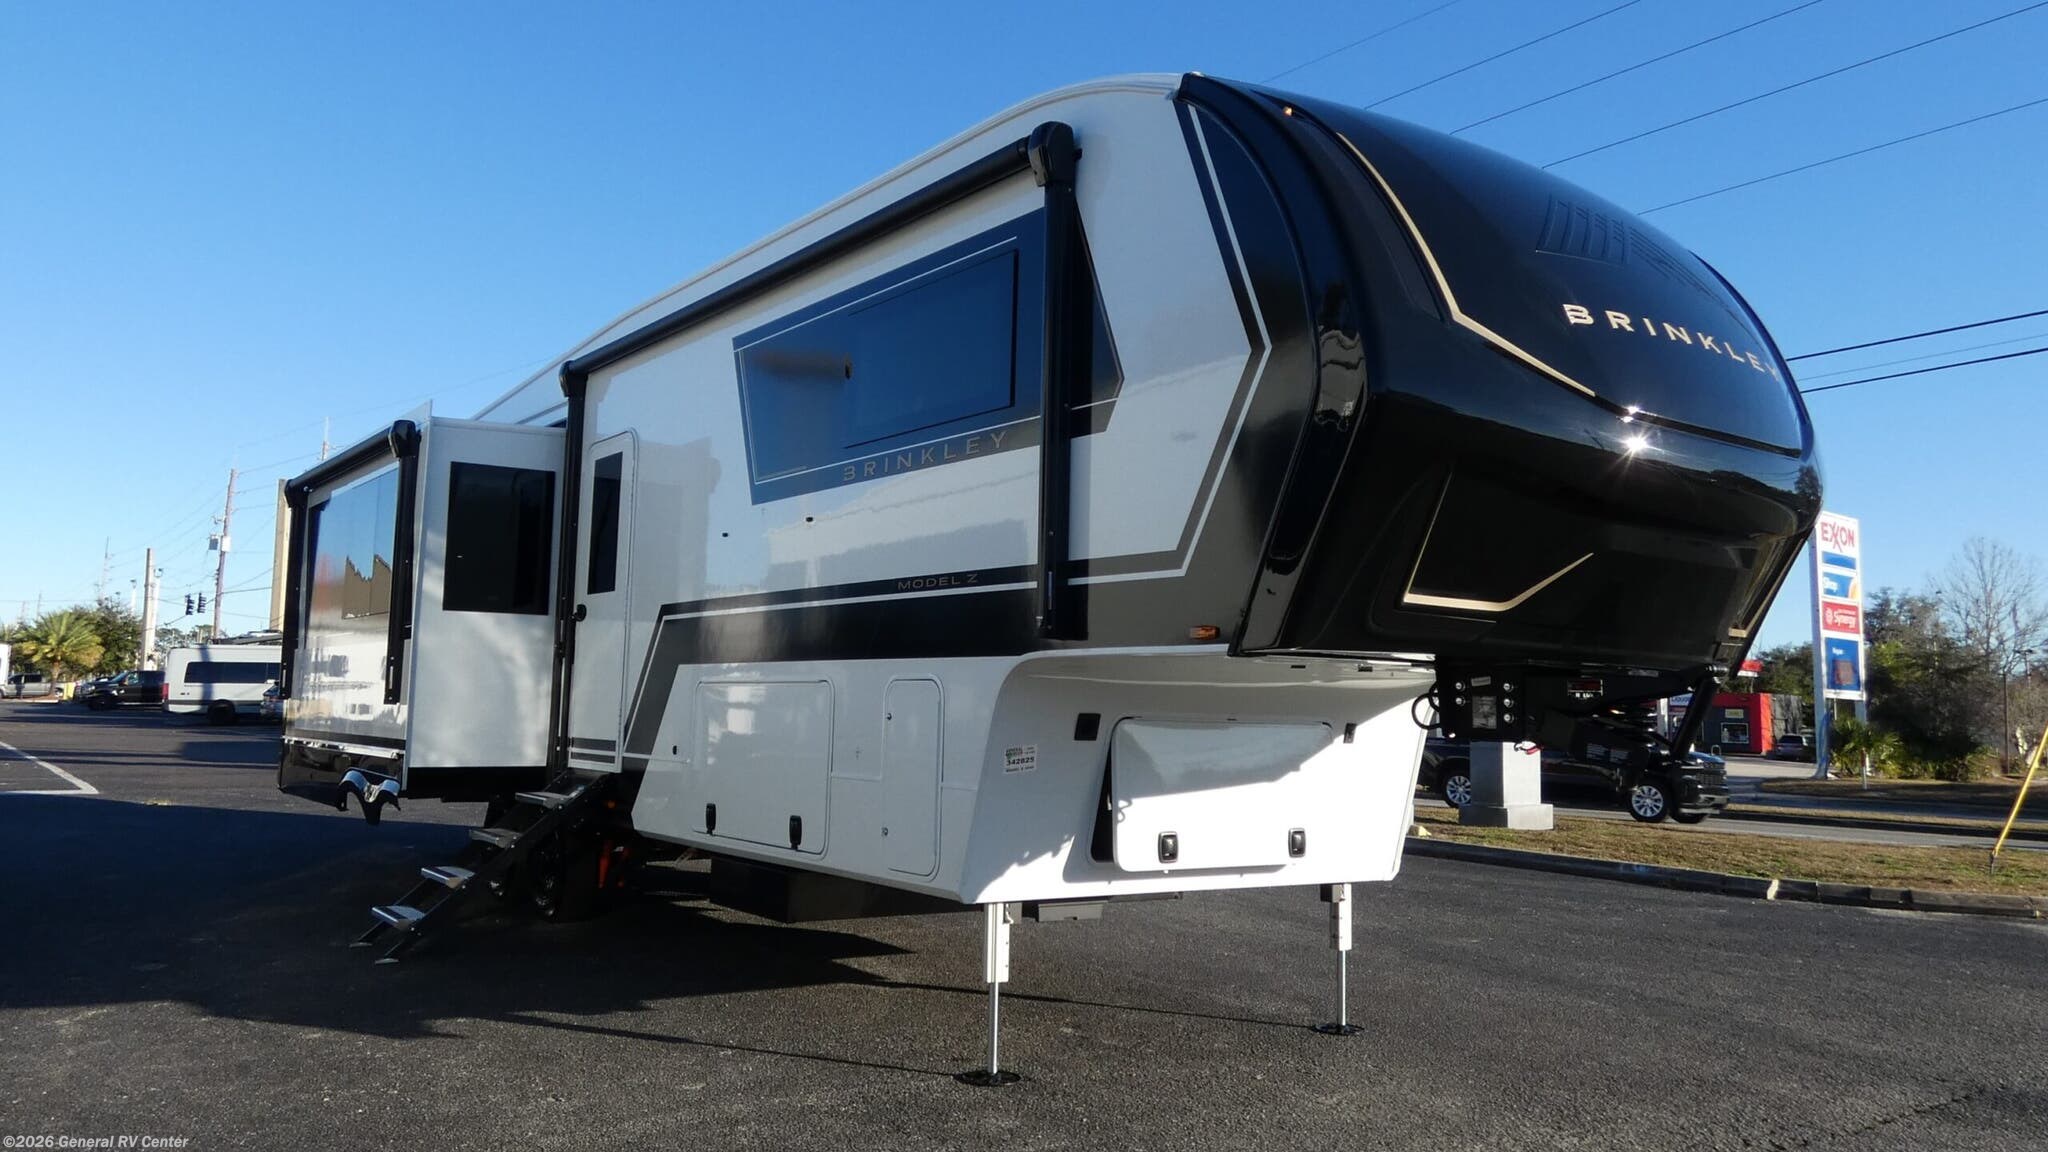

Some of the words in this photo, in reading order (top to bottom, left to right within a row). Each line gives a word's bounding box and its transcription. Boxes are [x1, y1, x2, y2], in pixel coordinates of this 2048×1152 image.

[1563, 304, 1779, 381] BRINKLEY
[843, 431, 1008, 481] BRINKLEY
[1820, 521, 1855, 553] EXXON
[898, 576, 960, 590] MODEL
[967, 574, 978, 584] Z
